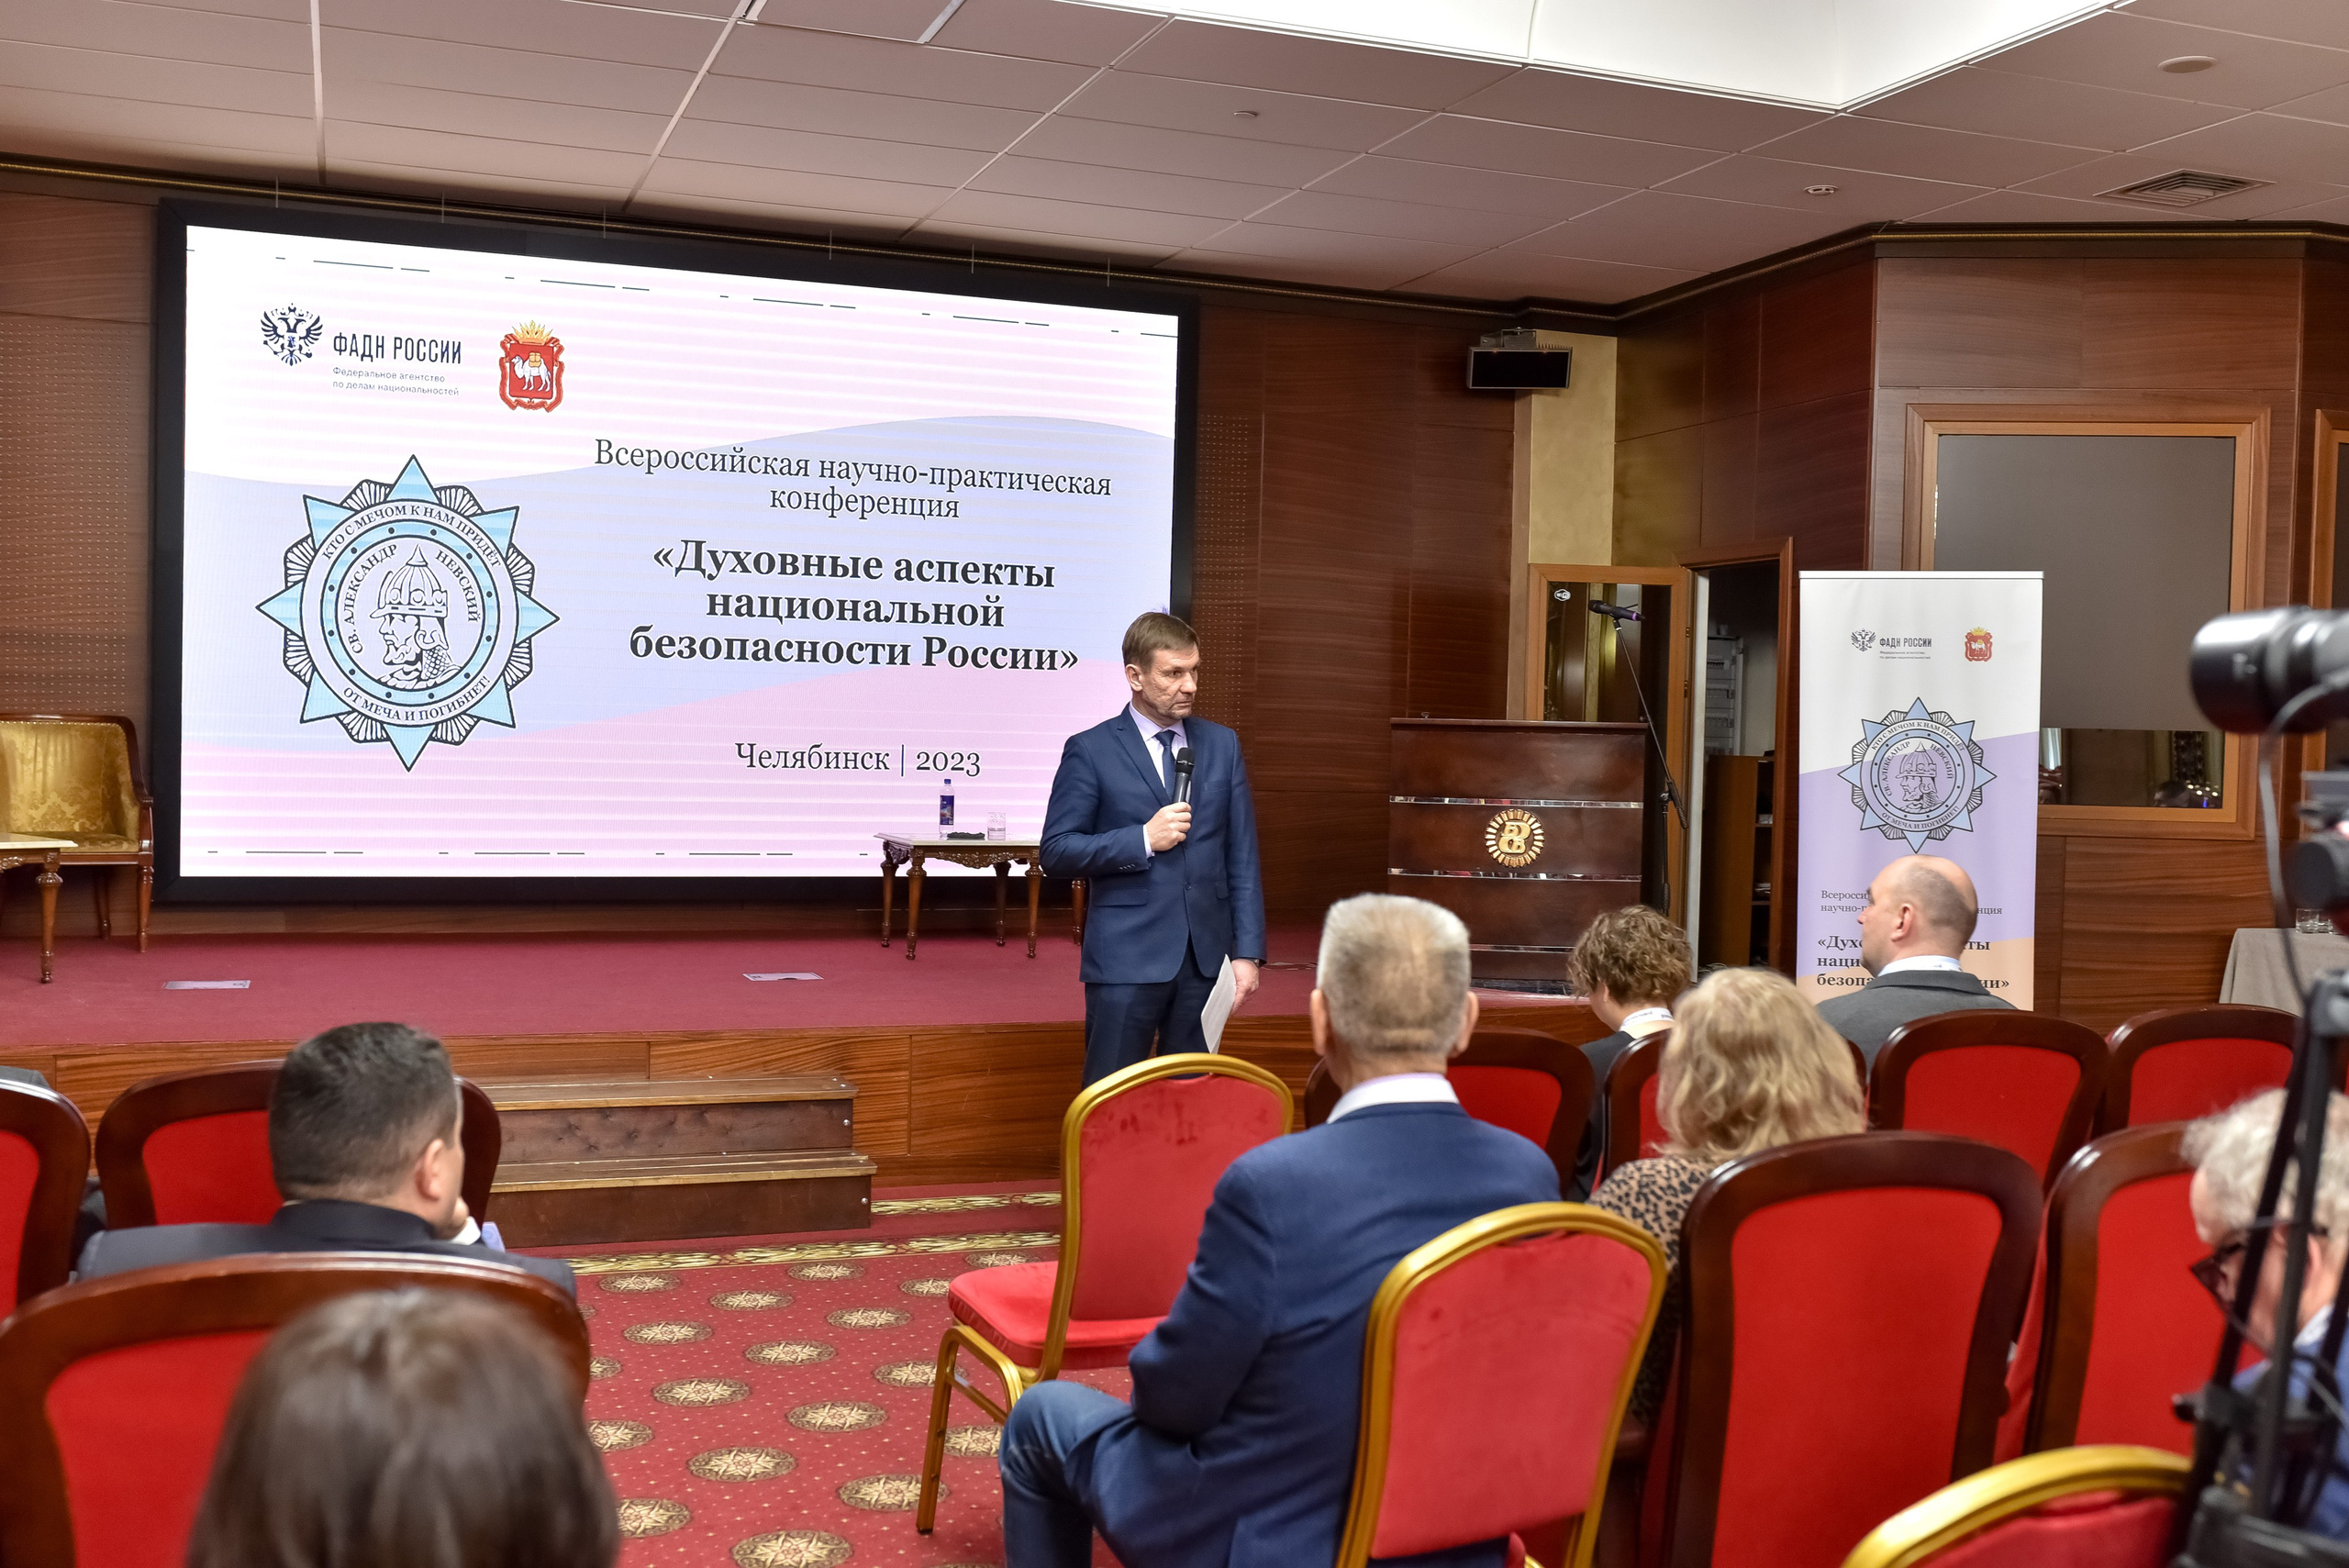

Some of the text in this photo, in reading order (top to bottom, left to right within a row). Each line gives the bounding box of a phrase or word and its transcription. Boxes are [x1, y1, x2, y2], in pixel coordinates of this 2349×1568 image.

[333, 332, 461, 364] ФАДН РОССИИ
[333, 367, 445, 383] Федеральное агентство
[346, 382, 375, 390] делам
[378, 384, 459, 395] национальностей
[595, 439, 1110, 496] Всероссийская научно-практическая
[770, 485, 960, 520] конференция
[322, 534, 345, 560] КТО
[345, 525, 355, 536] С
[354, 506, 408, 529] МЕЧОМ
[411, 506, 420, 516] К
[424, 506, 456, 526] НАМ
[654, 539, 1054, 587] «Духовные аспекты
[343, 544, 481, 654] СВ. АЛЕКСАНДР НЕВСКИЙ
[707, 588, 1004, 627] национальной
[630, 625, 1078, 671] безопасности России»
[1879, 637, 1932, 649] ФАДН РОССИИ
[343, 675, 490, 721] ОТ МЕЧА И ПОГИБНЕТ!
[735, 743, 890, 770] Челябинск
[917, 751, 981, 777] 2023
